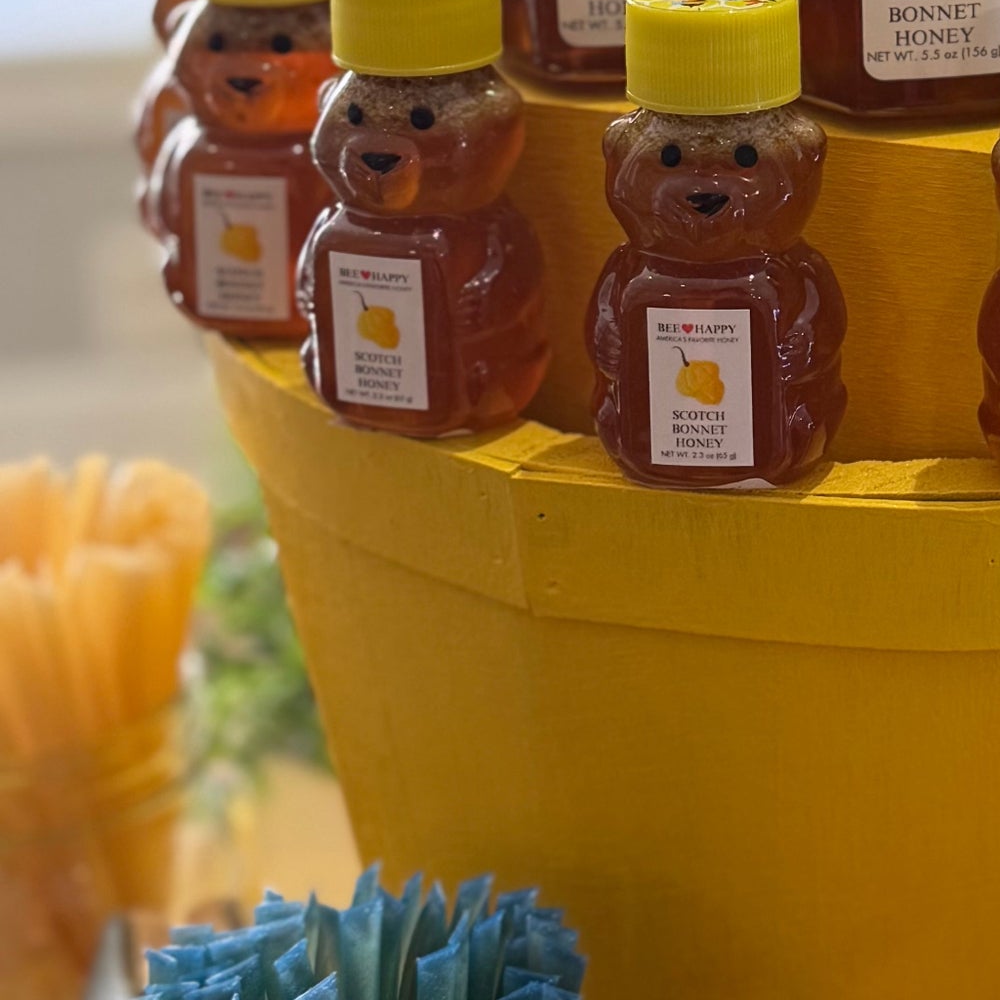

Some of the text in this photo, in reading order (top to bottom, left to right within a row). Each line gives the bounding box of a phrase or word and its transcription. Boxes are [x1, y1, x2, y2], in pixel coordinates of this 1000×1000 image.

[889, 3, 981, 23] BONNET
[895, 26, 975, 46] HONEY
[867, 51, 890, 62] NET
[894, 50, 918, 61] WT.
[921, 49, 941, 61] 5.5
[944, 50, 958, 60] oz
[961, 46, 988, 60] (156
[372, 271, 410, 283] HAPPY
[658, 322, 736, 334] BEE HAPPY
[354, 351, 401, 366] SCOTCH
[354, 364, 403, 379] BONNET
[357, 377, 401, 391] HONEY
[672, 410, 725, 421] SCOTCH
[672, 424, 728, 435] BONNET
[676, 437, 724, 449] HONEY
